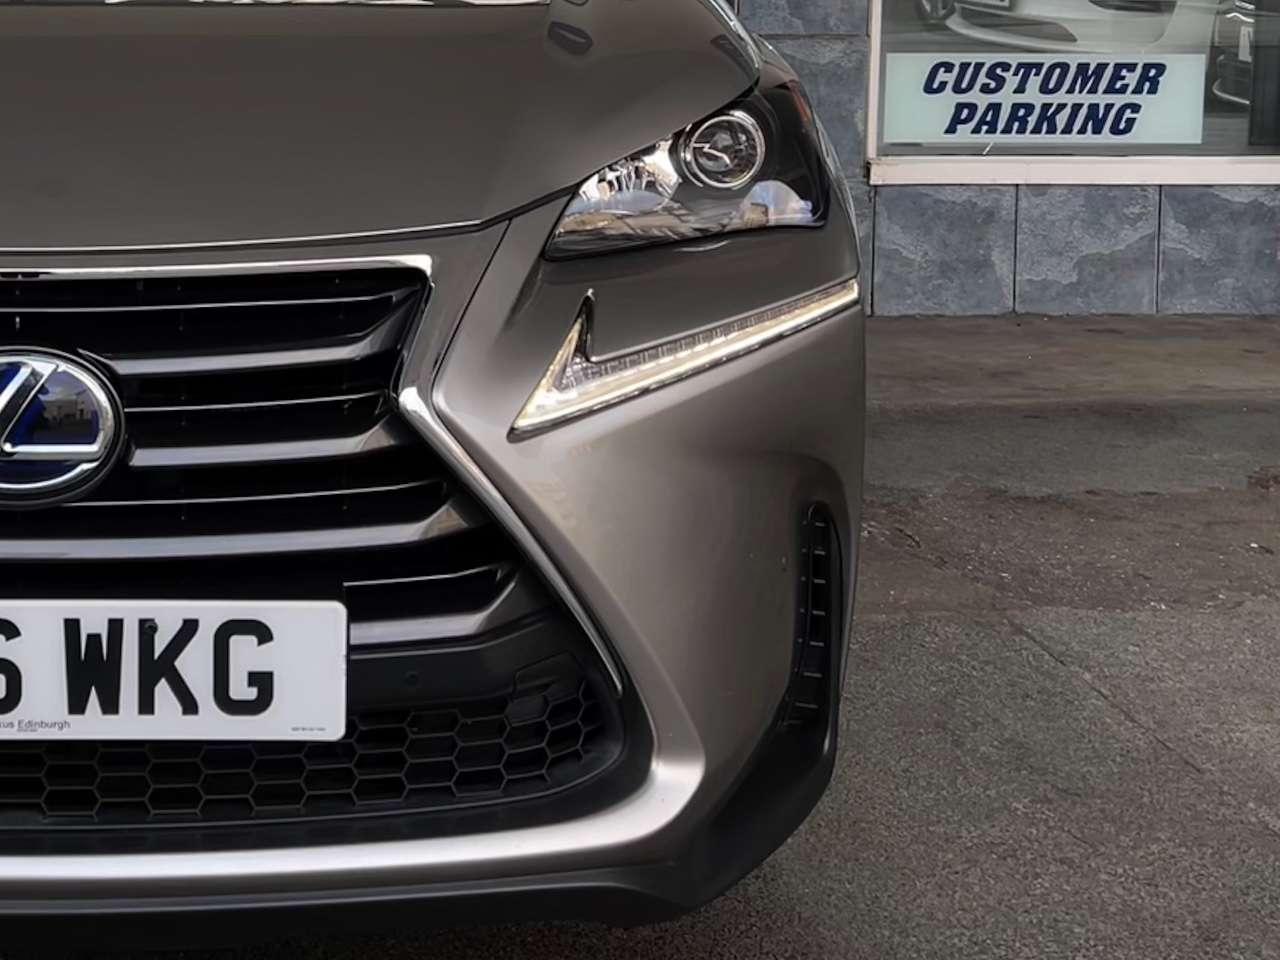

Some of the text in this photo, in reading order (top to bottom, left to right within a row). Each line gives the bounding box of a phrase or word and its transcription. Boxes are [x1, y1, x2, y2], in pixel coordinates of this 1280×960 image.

[923, 61, 1167, 95] CUSTOMER
[944, 102, 1142, 136] PARKING
[63, 617, 275, 716] WKG
[17, 719, 72, 731] Edinburgh
